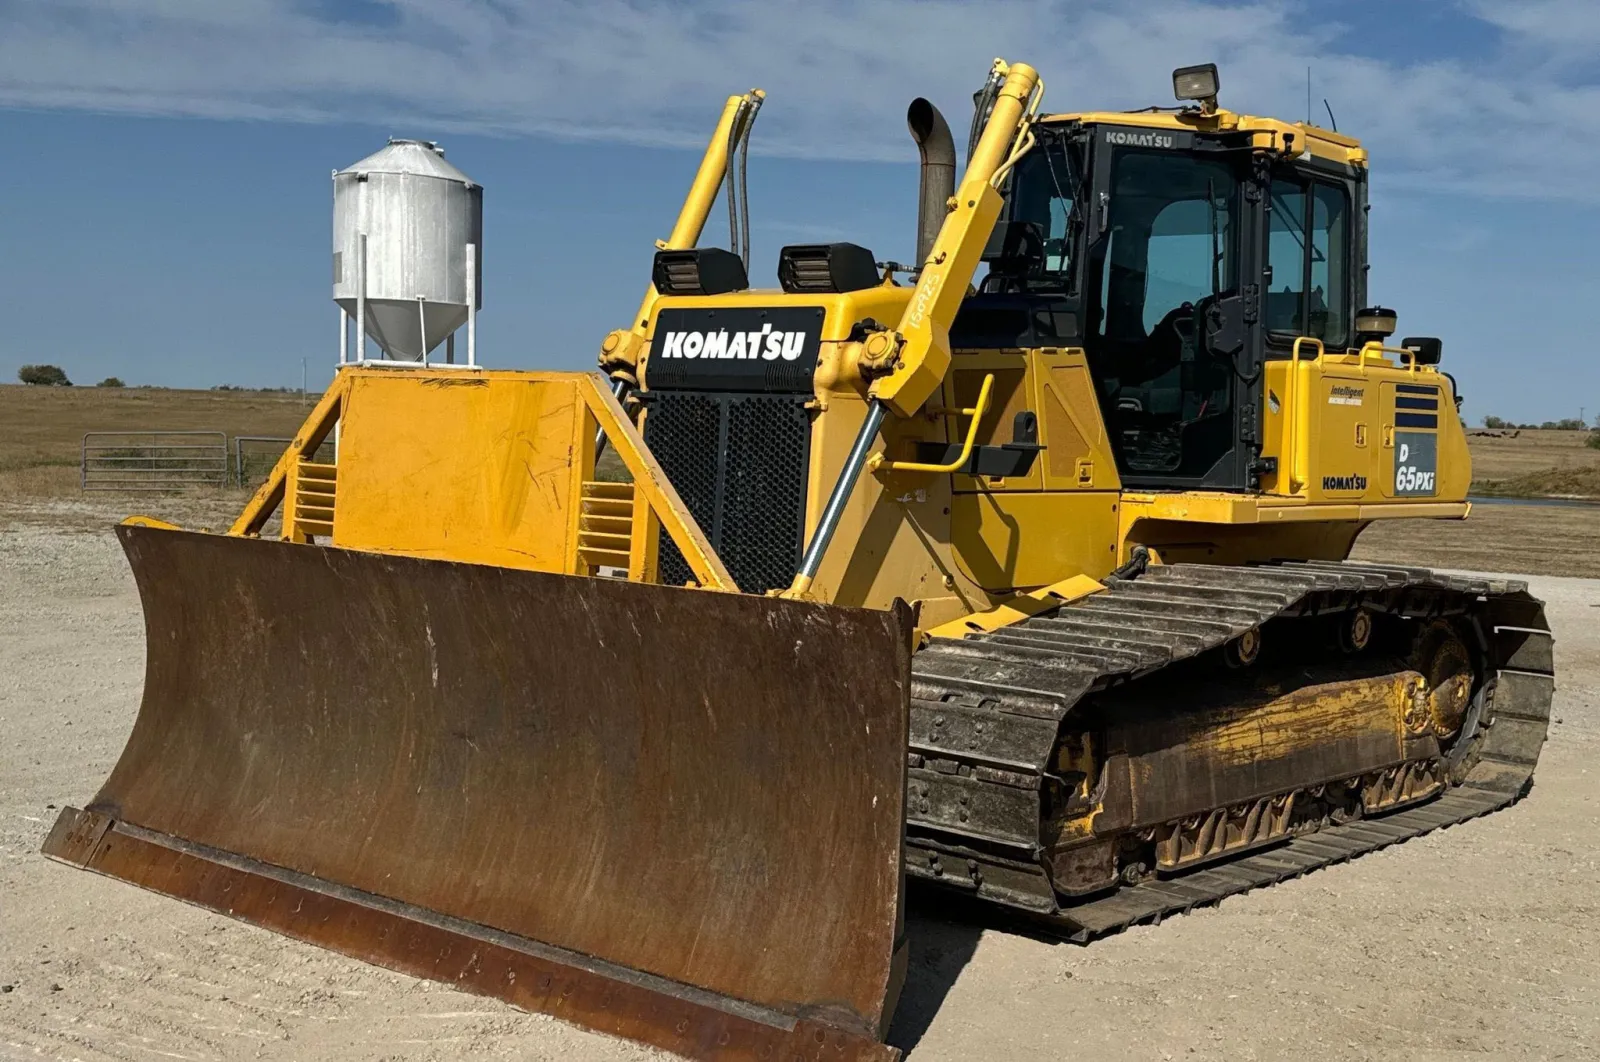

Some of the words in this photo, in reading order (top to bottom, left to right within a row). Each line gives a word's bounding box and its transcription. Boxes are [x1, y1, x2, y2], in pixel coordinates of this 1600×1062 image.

[1105, 131, 1172, 148] KOMATSU
[661, 323, 806, 361] KOMATSU
[1399, 444, 1409, 463] D
[1322, 473, 1367, 490] KOMATSU
[1396, 466, 1435, 491] 65PXi
